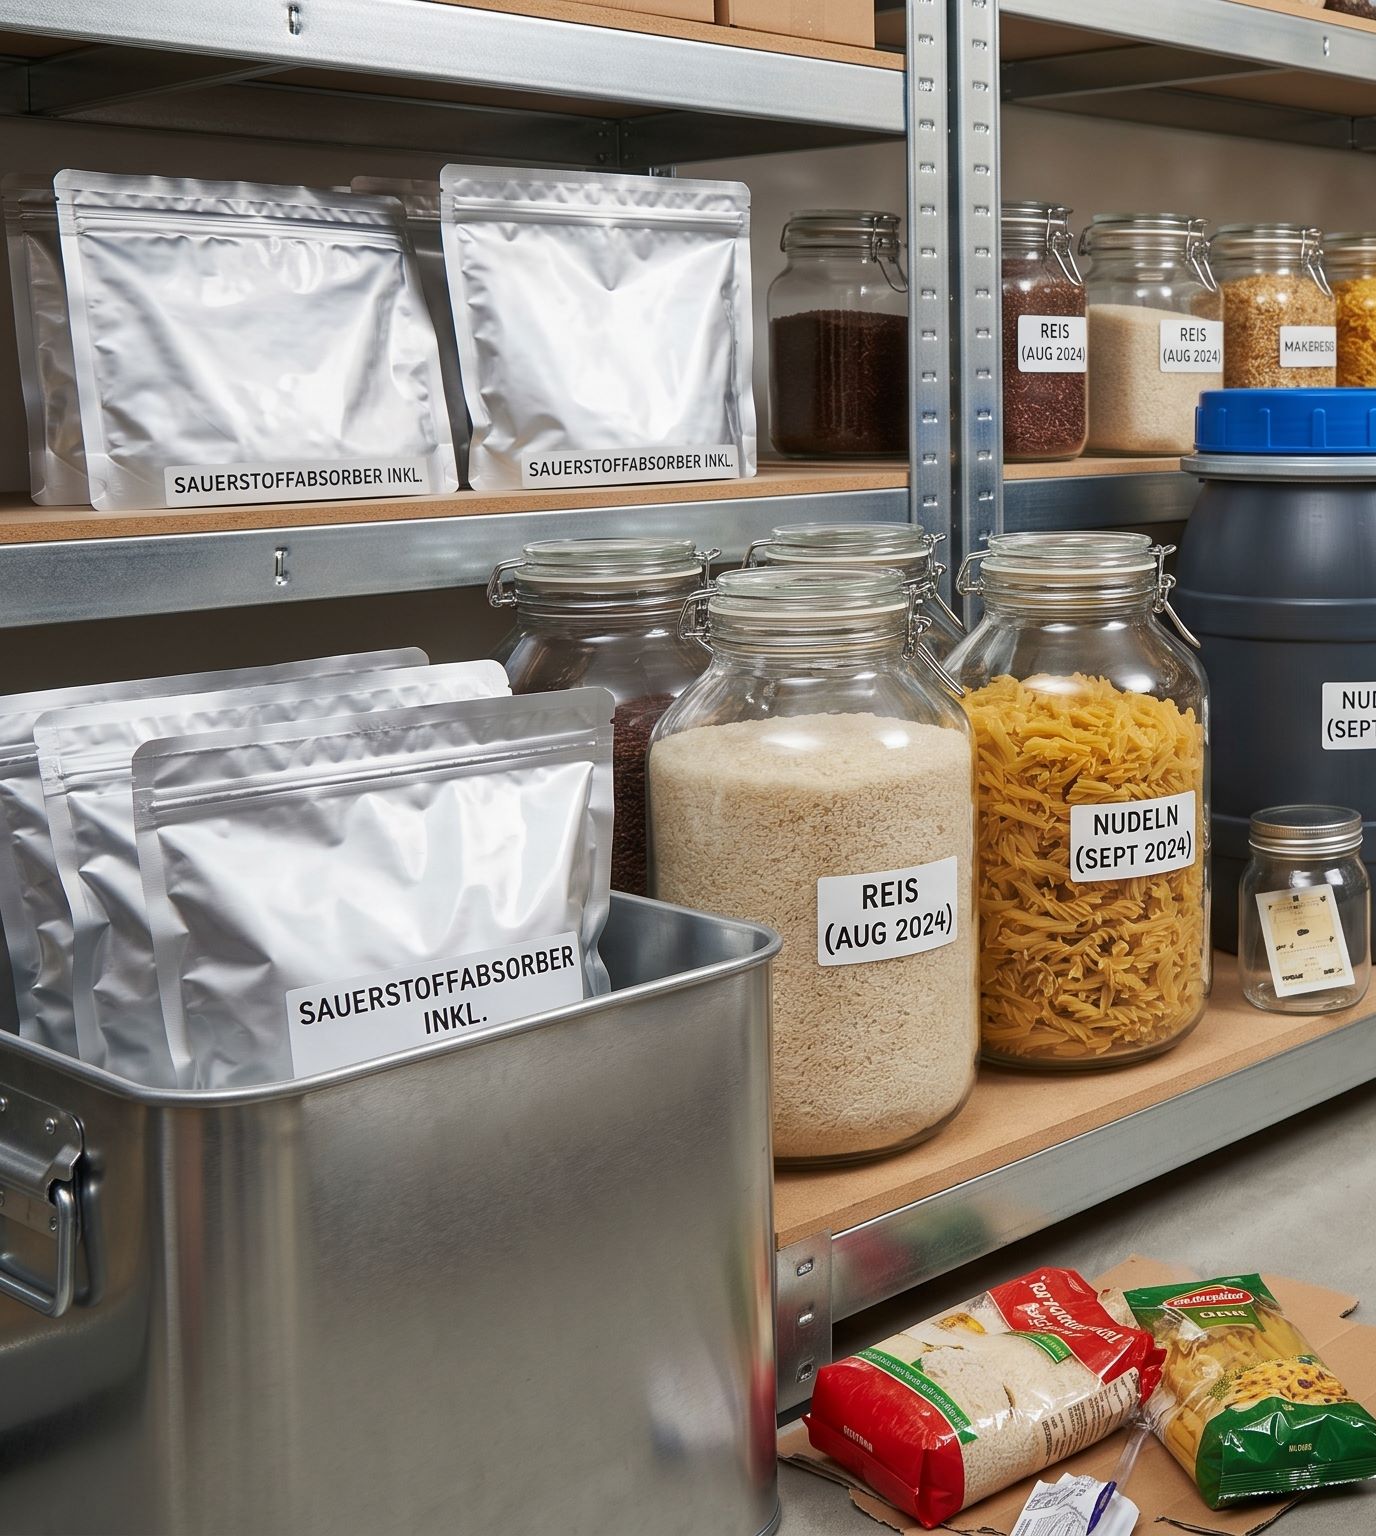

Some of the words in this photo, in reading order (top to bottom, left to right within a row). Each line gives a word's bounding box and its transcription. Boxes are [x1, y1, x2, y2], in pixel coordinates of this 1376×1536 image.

[1041, 323, 1069, 339] REIS
[1180, 327, 1207, 342] REIS
[1021, 345, 1053, 363] (AUG
[1056, 346, 1086, 363] 2024)
[1163, 348, 1191, 364] (AUG
[1194, 348, 1221, 364] 2024)
[529, 454, 701, 477] SAUERSTOFFABSORBER
[705, 453, 734, 468] INKL.
[174, 468, 383, 494] SAUERSTOFFABSORBER
[387, 467, 423, 483] INKL.
[1094, 804, 1178, 836] NUDELN
[1075, 844, 1139, 874] (SEPT
[1144, 830, 1192, 863] 2024)
[862, 877, 919, 910] REIS
[824, 921, 887, 956] (AUG
[895, 902, 953, 942] 2024)
[299, 945, 575, 1026] SAUERSTOFFABSORBER
[423, 1002, 488, 1035] INKL.
